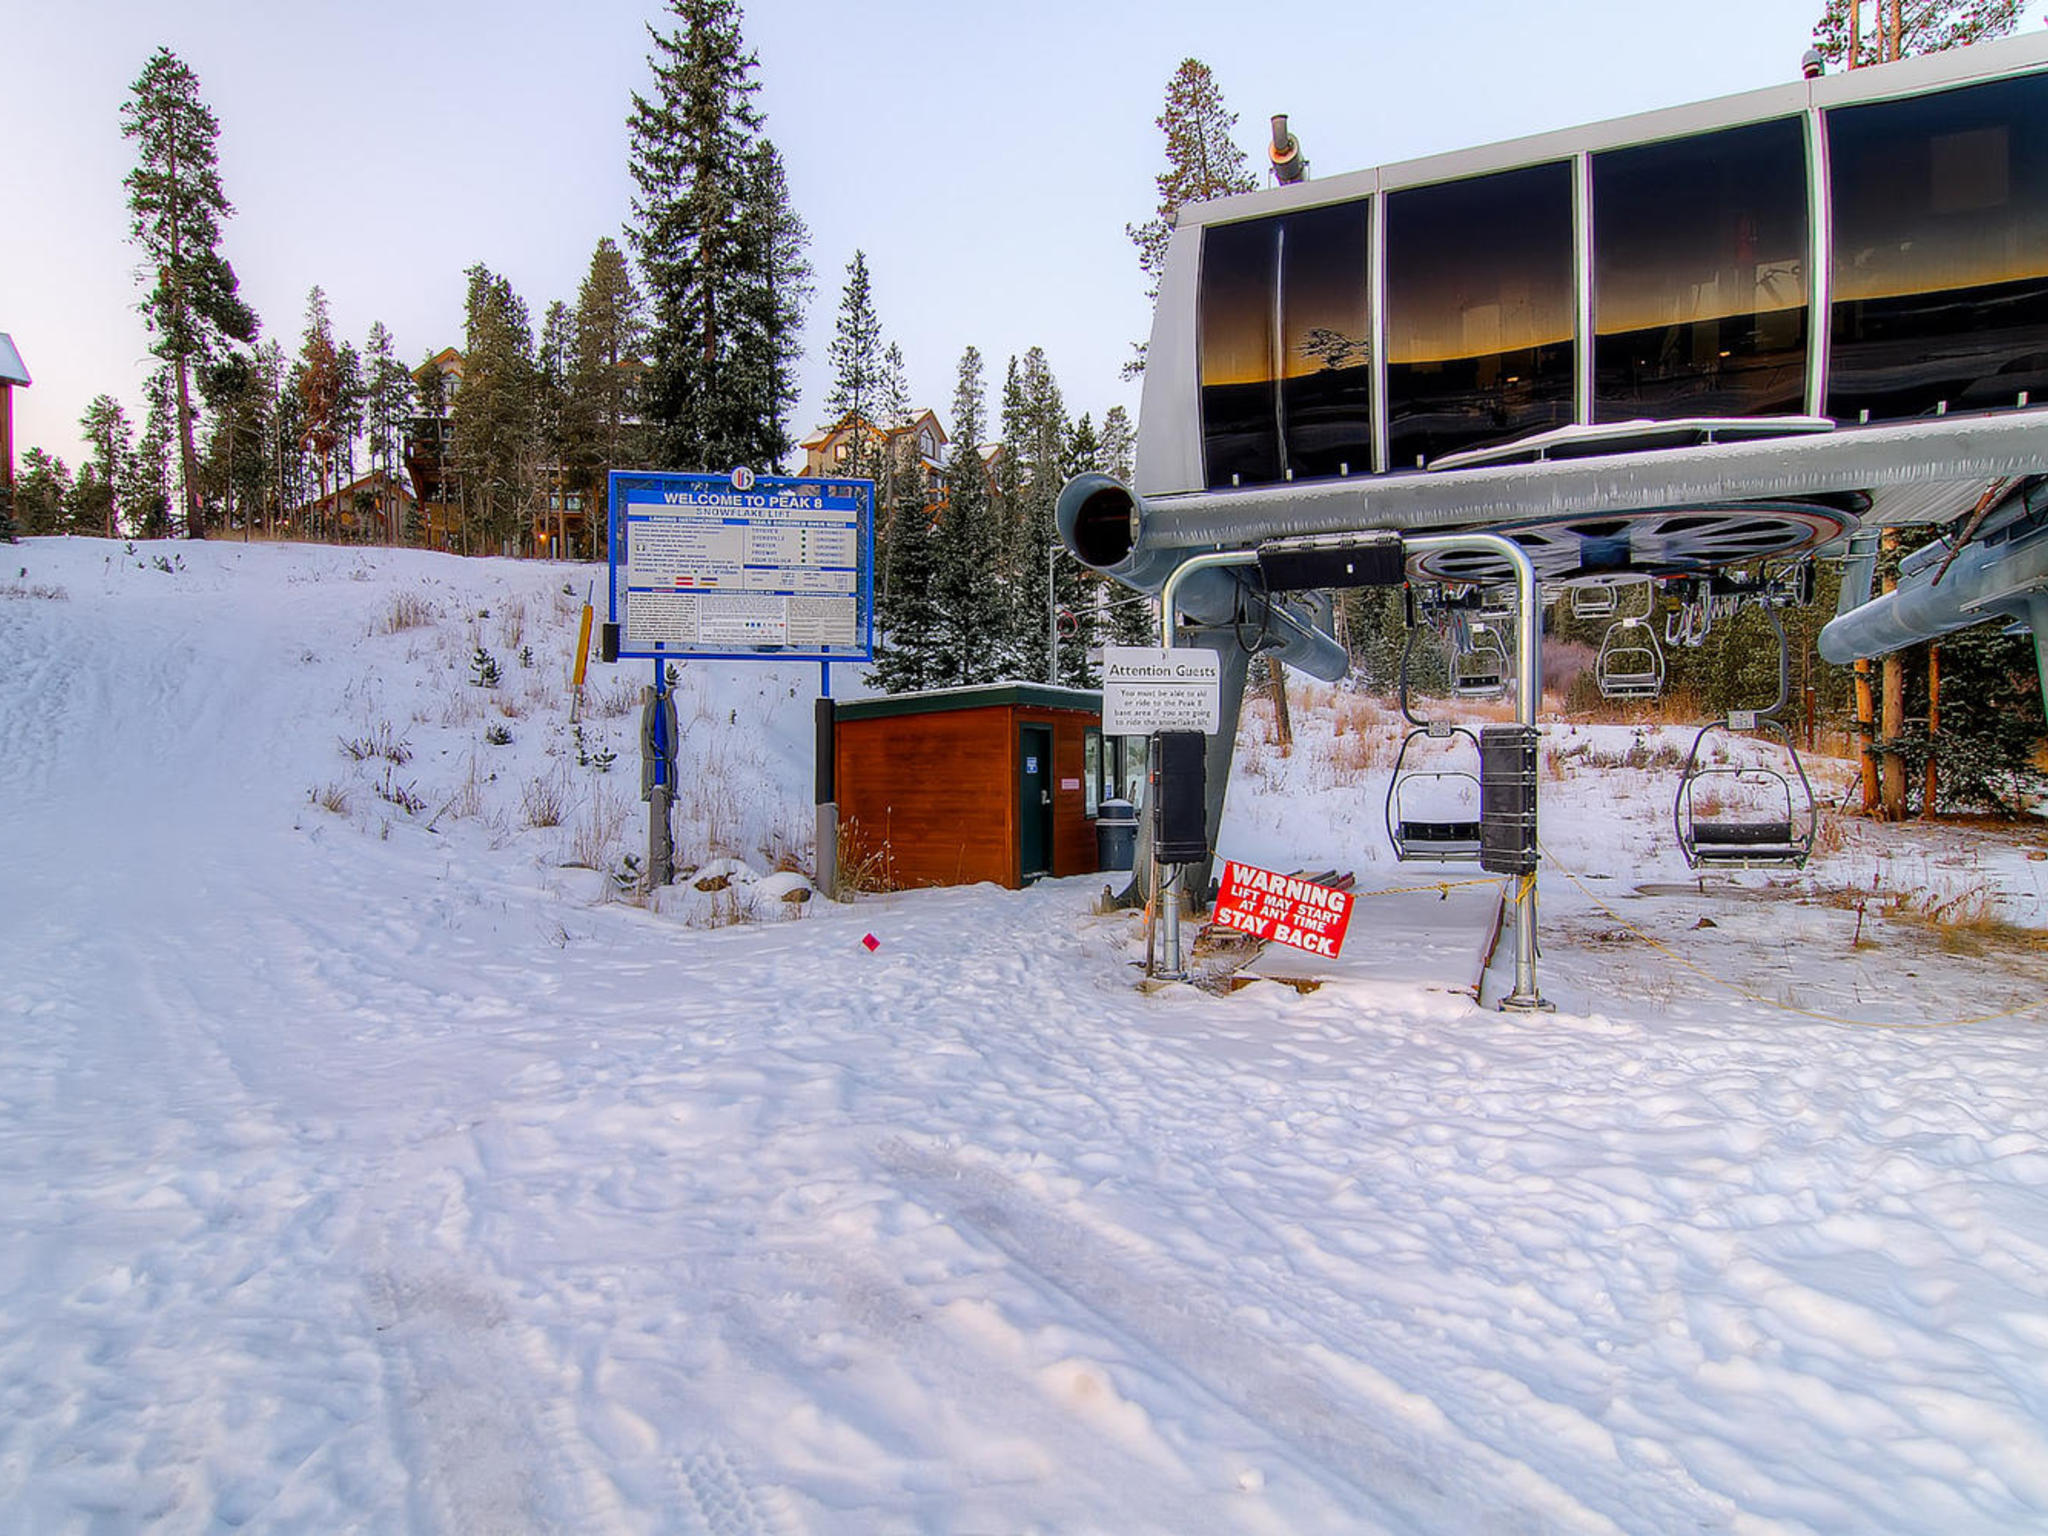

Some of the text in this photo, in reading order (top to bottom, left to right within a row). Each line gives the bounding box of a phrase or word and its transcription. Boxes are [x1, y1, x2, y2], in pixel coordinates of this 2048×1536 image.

[664, 492, 822, 509] WELCOME TO PEAK 8
[696, 507, 791, 518] SNOWFLAKE LIFT
[1109, 664, 1216, 677] Attention Guests
[1162, 709, 1176, 717] you
[1193, 709, 1211, 717] going
[1232, 864, 1346, 913] WARNING
[1231, 884, 1342, 925] LIFT MAY START
[1239, 900, 1328, 933] AT ANY TIME
[1217, 907, 1336, 957] STAY BACK
